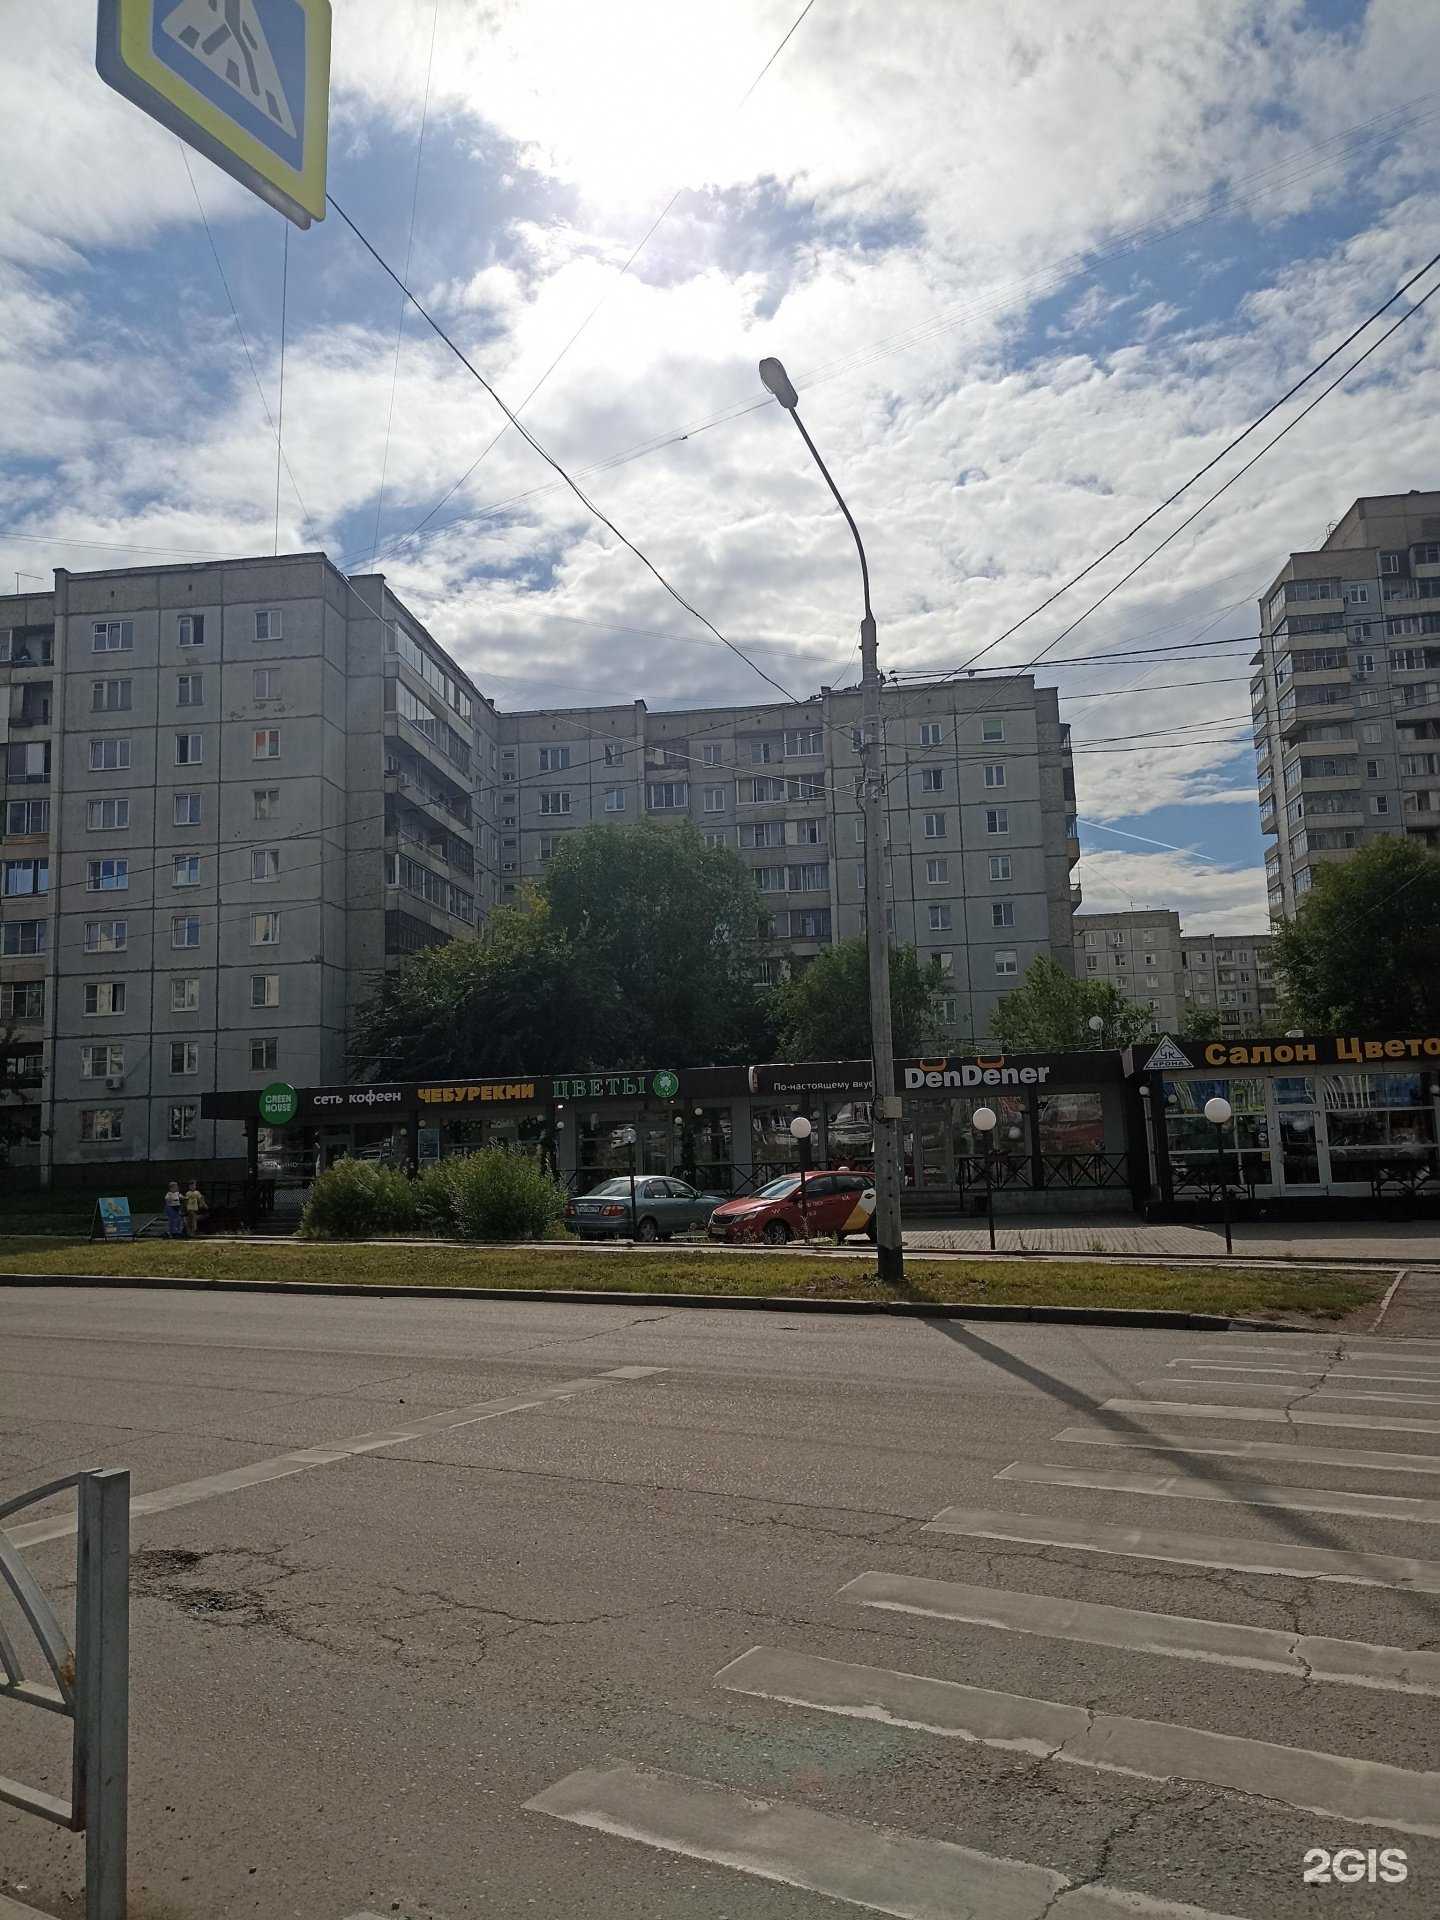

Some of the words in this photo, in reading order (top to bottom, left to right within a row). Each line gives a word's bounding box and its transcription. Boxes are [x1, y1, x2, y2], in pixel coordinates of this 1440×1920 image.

[1204, 1043, 1317, 1066] Салон
[1335, 1036, 1440, 1064] Цвето
[774, 1079, 850, 1092] По-настоящему
[904, 1064, 1050, 1089] DenDener
[417, 1083, 536, 1103] ЧЕБУРЕКМИ
[552, 1076, 648, 1099] ЦВЕТЫ
[265, 1094, 292, 1104] GREEN
[313, 1095, 344, 1105] сеть
[348, 1089, 402, 1106] кофеен
[265, 1104, 292, 1112] HOUSE
